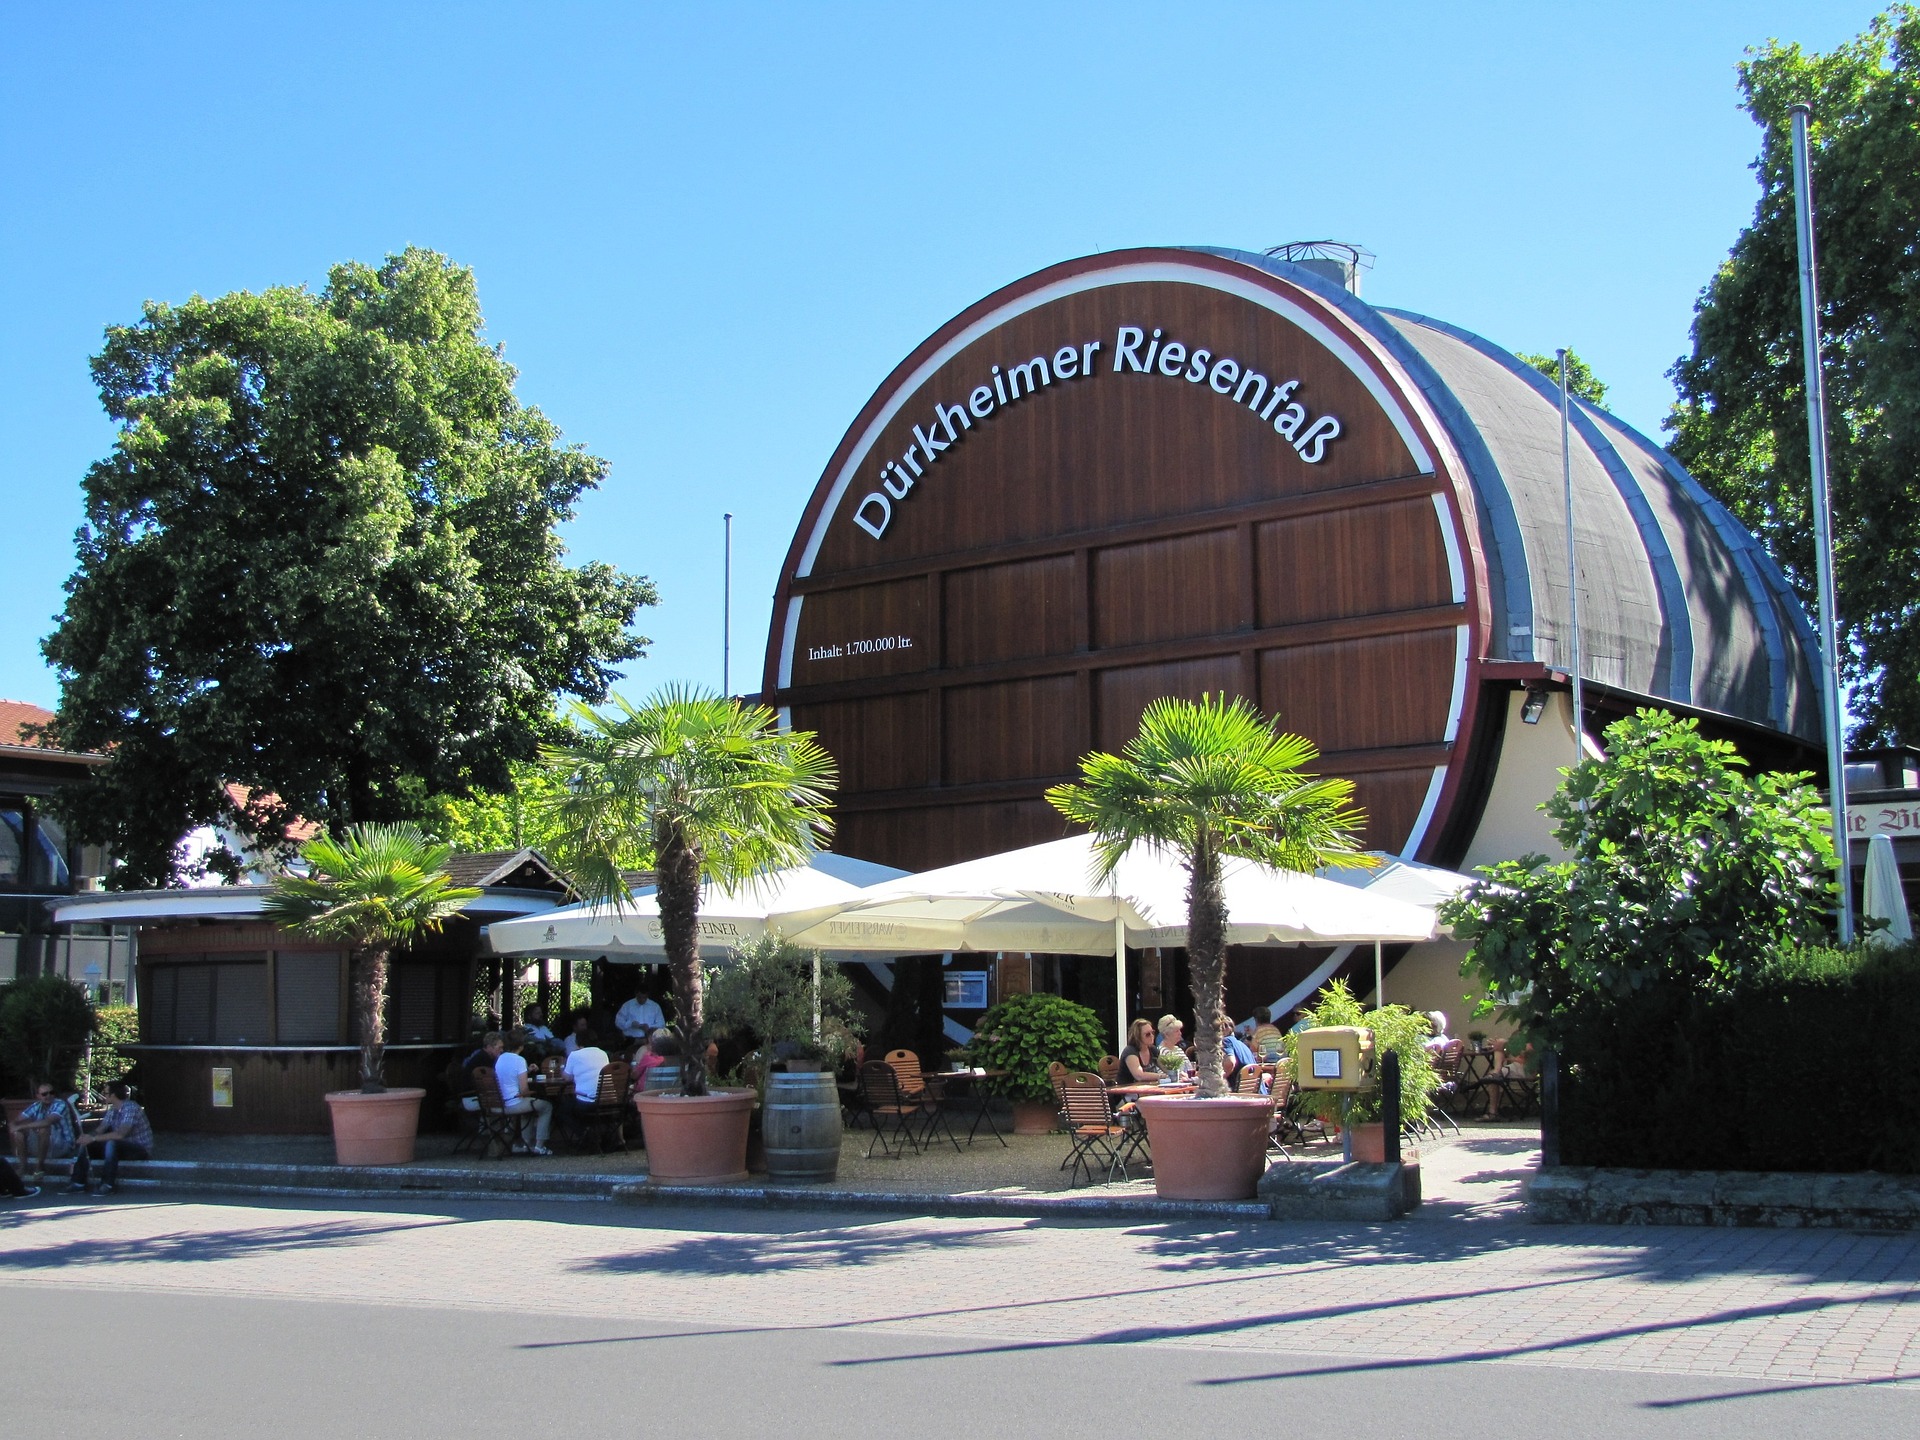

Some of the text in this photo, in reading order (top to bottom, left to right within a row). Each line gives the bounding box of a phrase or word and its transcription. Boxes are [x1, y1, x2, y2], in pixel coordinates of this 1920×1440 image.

[853, 327, 1340, 540] Dürkheimer Riesenfaß
[808, 635, 913, 660] Inhalt: 1.700.000 ltr.
